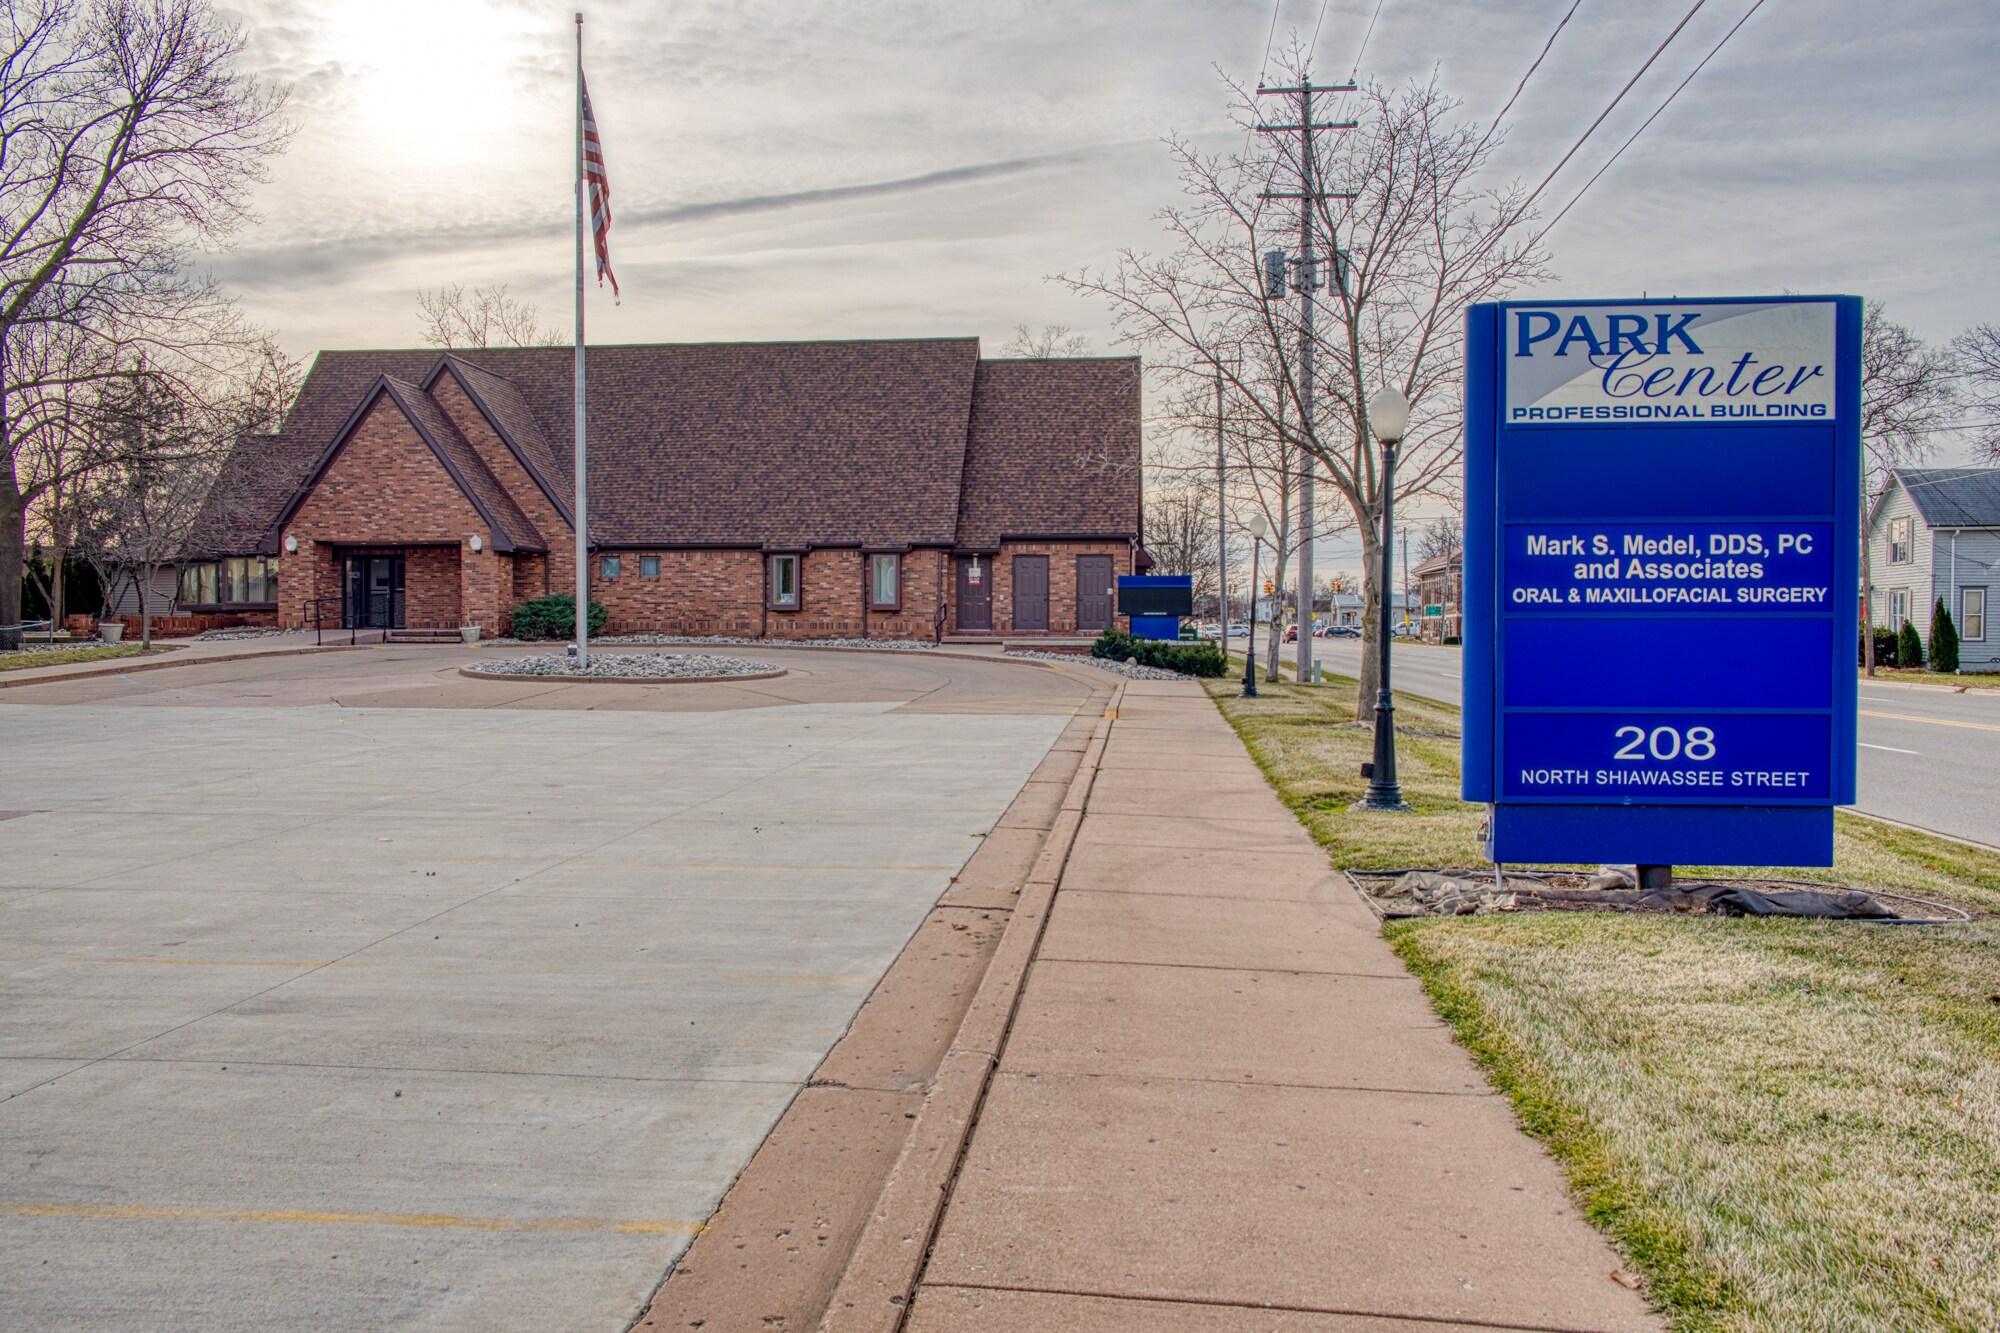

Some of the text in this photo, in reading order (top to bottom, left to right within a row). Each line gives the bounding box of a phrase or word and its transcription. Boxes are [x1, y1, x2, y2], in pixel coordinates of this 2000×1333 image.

[1515, 311, 1704, 357] PARK
[1589, 341, 1824, 398] Center
[1512, 403, 1828, 420] PROFESSIONAL BUILDING
[1527, 533, 1813, 558] Mark S. Medel, DDS, PC
[1574, 558, 1764, 579] and Associates
[1512, 587, 1828, 603] ORAL & MAXILLOFACIAL SURGERY
[1613, 726, 1717, 761] 208
[1522, 769, 1810, 787] NORTH SHIAWASSEE STREET
